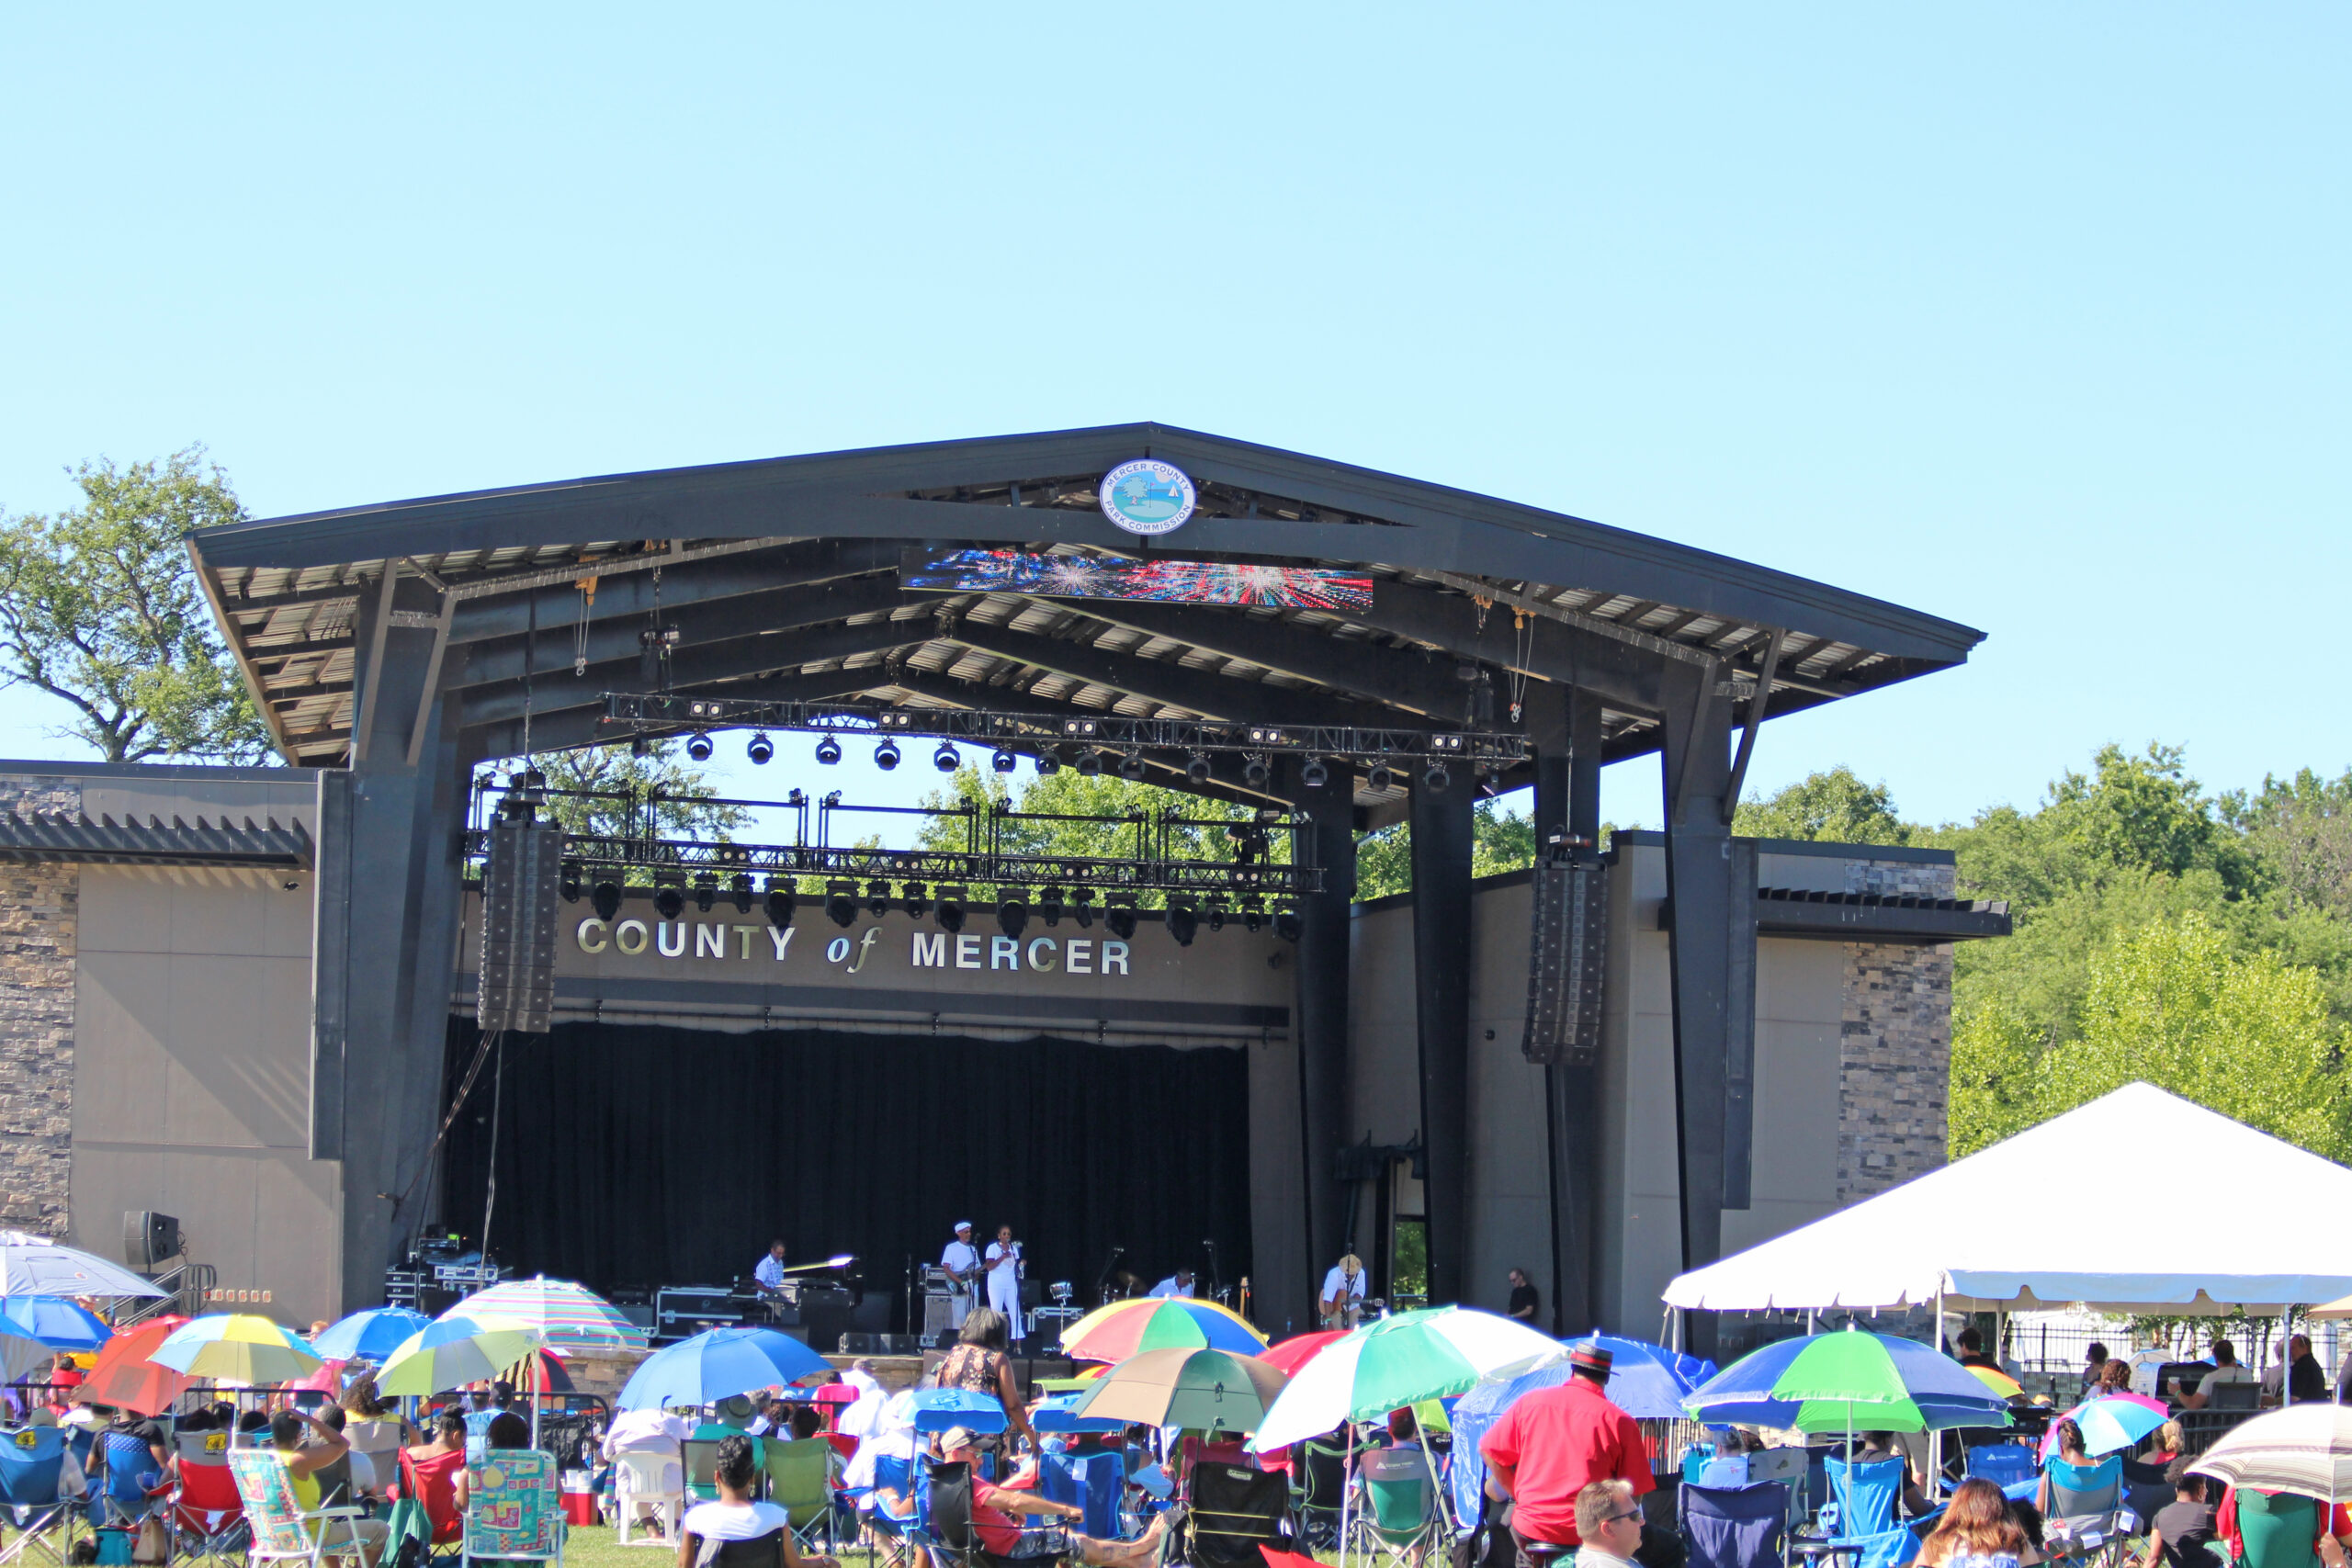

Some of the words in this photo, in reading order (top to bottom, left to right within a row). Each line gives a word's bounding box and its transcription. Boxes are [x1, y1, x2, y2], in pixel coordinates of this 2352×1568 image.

[1107, 463, 1148, 489] MERCER
[1152, 463, 1191, 491] COUNTY
[1105, 500, 1126, 525] PARK
[1128, 504, 1191, 532] COMMISSION
[576, 918, 796, 961] COUNTY
[827, 926, 883, 974] of
[911, 931, 1130, 976] MERCER
